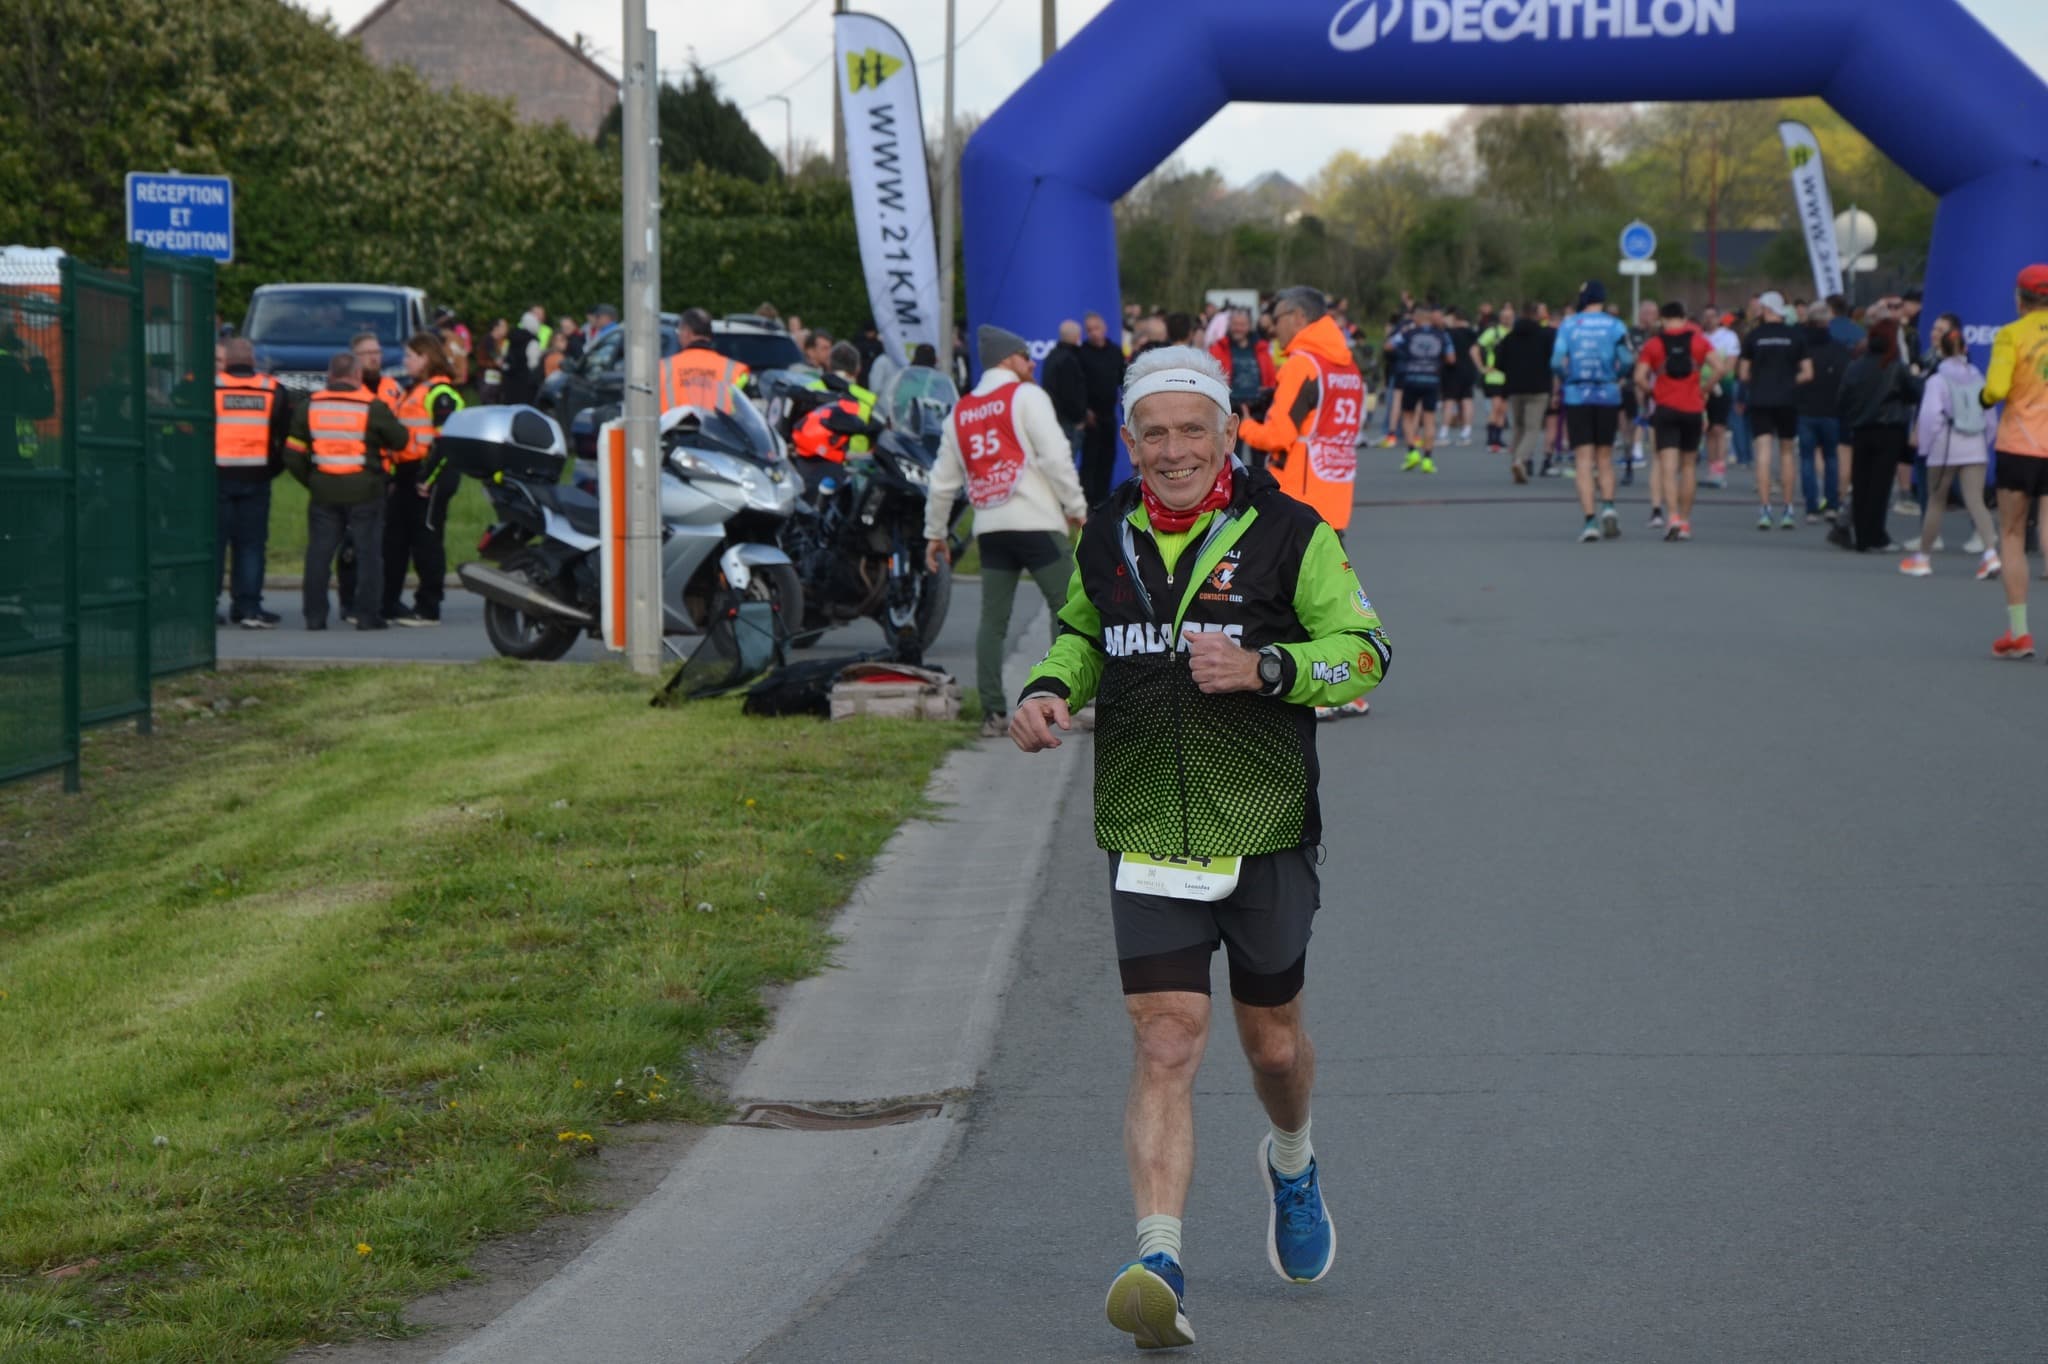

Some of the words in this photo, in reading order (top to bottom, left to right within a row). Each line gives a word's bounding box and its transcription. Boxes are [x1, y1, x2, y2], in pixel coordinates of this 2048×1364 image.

[1411, 0, 1735, 42] DECATHLON
[136, 181, 225, 205] RÉCEPTION
[170, 207, 191, 227] ET
[1328, 373, 1361, 390] PHOTO
[960, 400, 1005, 426] PHOTO
[1334, 398, 1357, 424] 52
[969, 429, 1001, 460] 35
